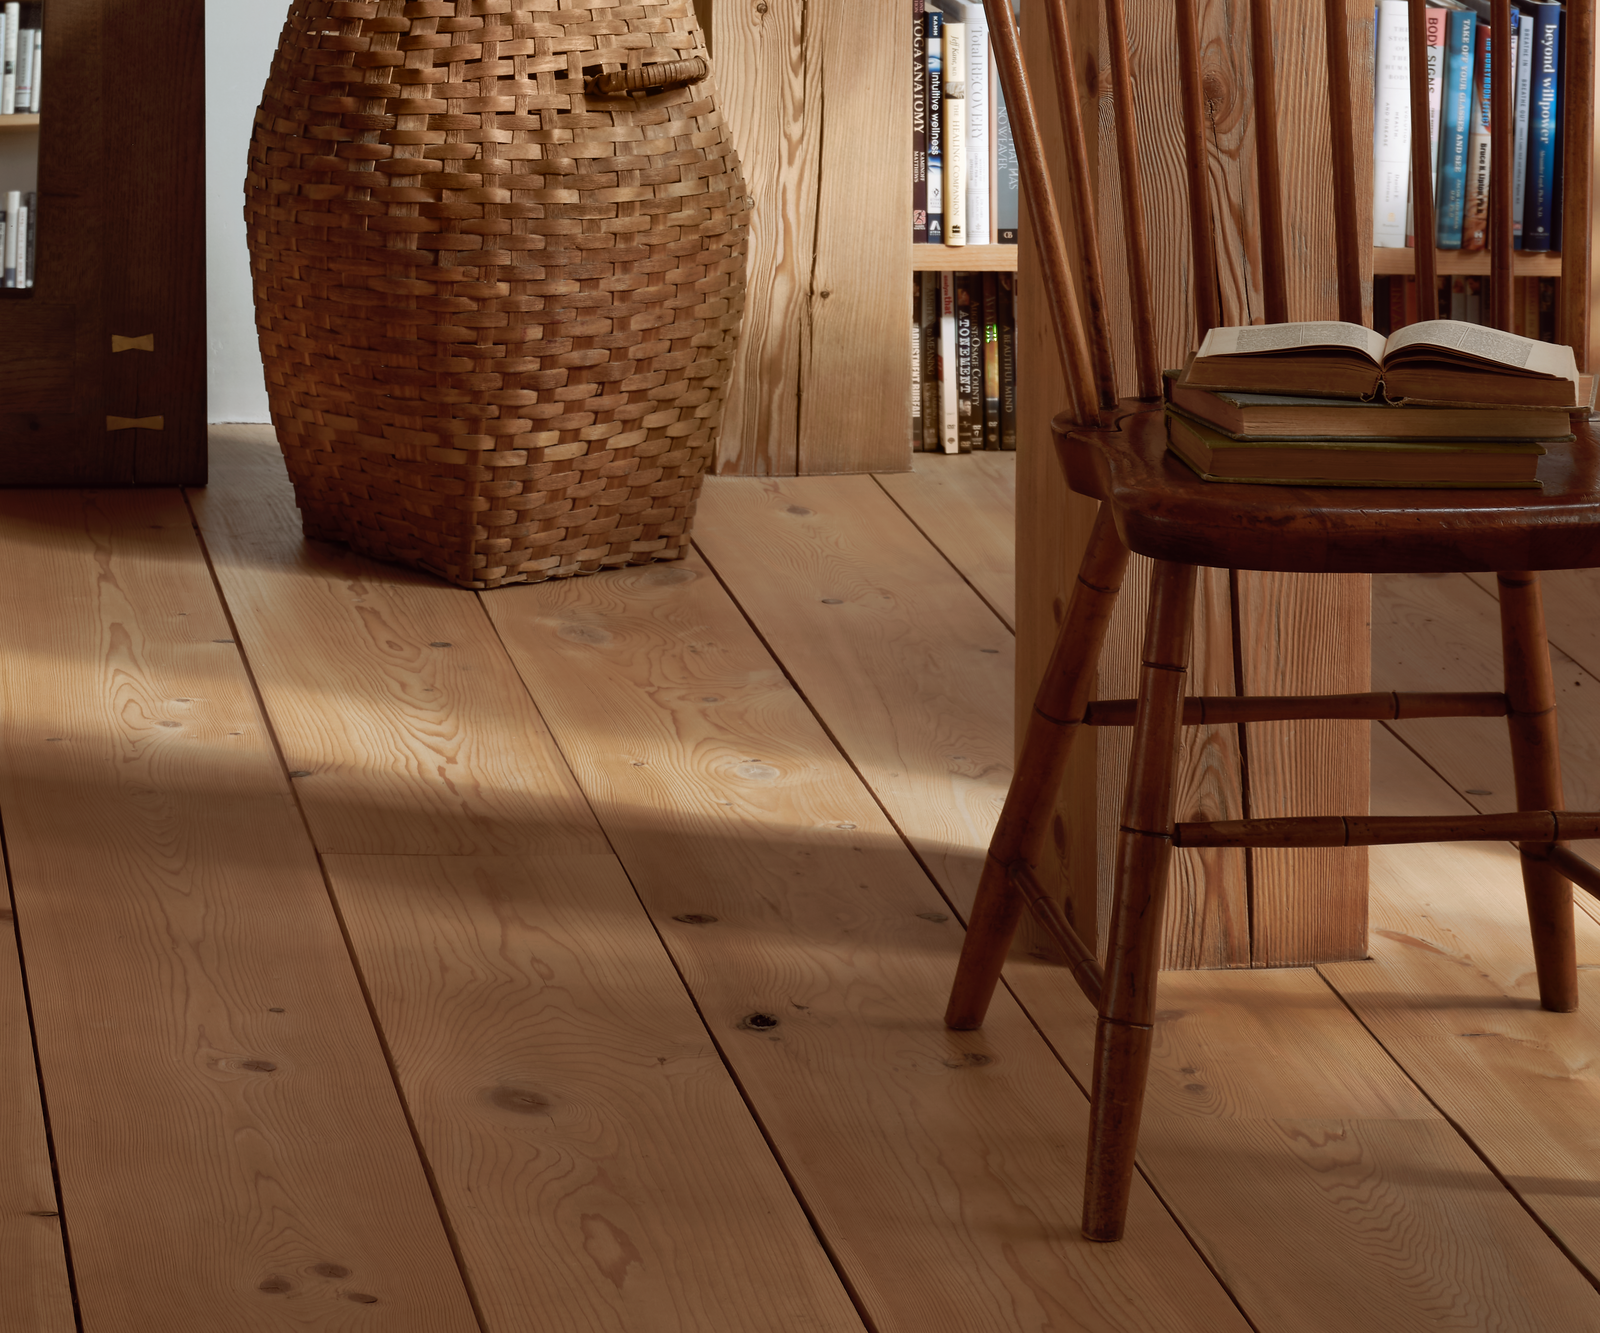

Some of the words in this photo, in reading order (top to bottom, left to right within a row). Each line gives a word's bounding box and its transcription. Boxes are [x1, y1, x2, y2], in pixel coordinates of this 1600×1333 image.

[913, 17, 925, 54] YOGA
[971, 26, 984, 59] Total
[1462, 19, 1470, 43] TAKE
[1541, 24, 1556, 73] beyond
[1460, 45, 1470, 63] OFF
[913, 57, 925, 134] ANATOMY
[1459, 66, 1468, 91] YOUR
[970, 63, 984, 141] RECOVERY
[1456, 92, 1466, 133] GLASSES
[1538, 77, 1555, 144] willpower
[1455, 134, 1464, 153] AND
[1454, 155, 1462, 173] SEE
[959, 310, 971, 394] ATONEMENT
[1003, 334, 1013, 385] BEAUTIFUL
[1005, 388, 1013, 413] MIND
